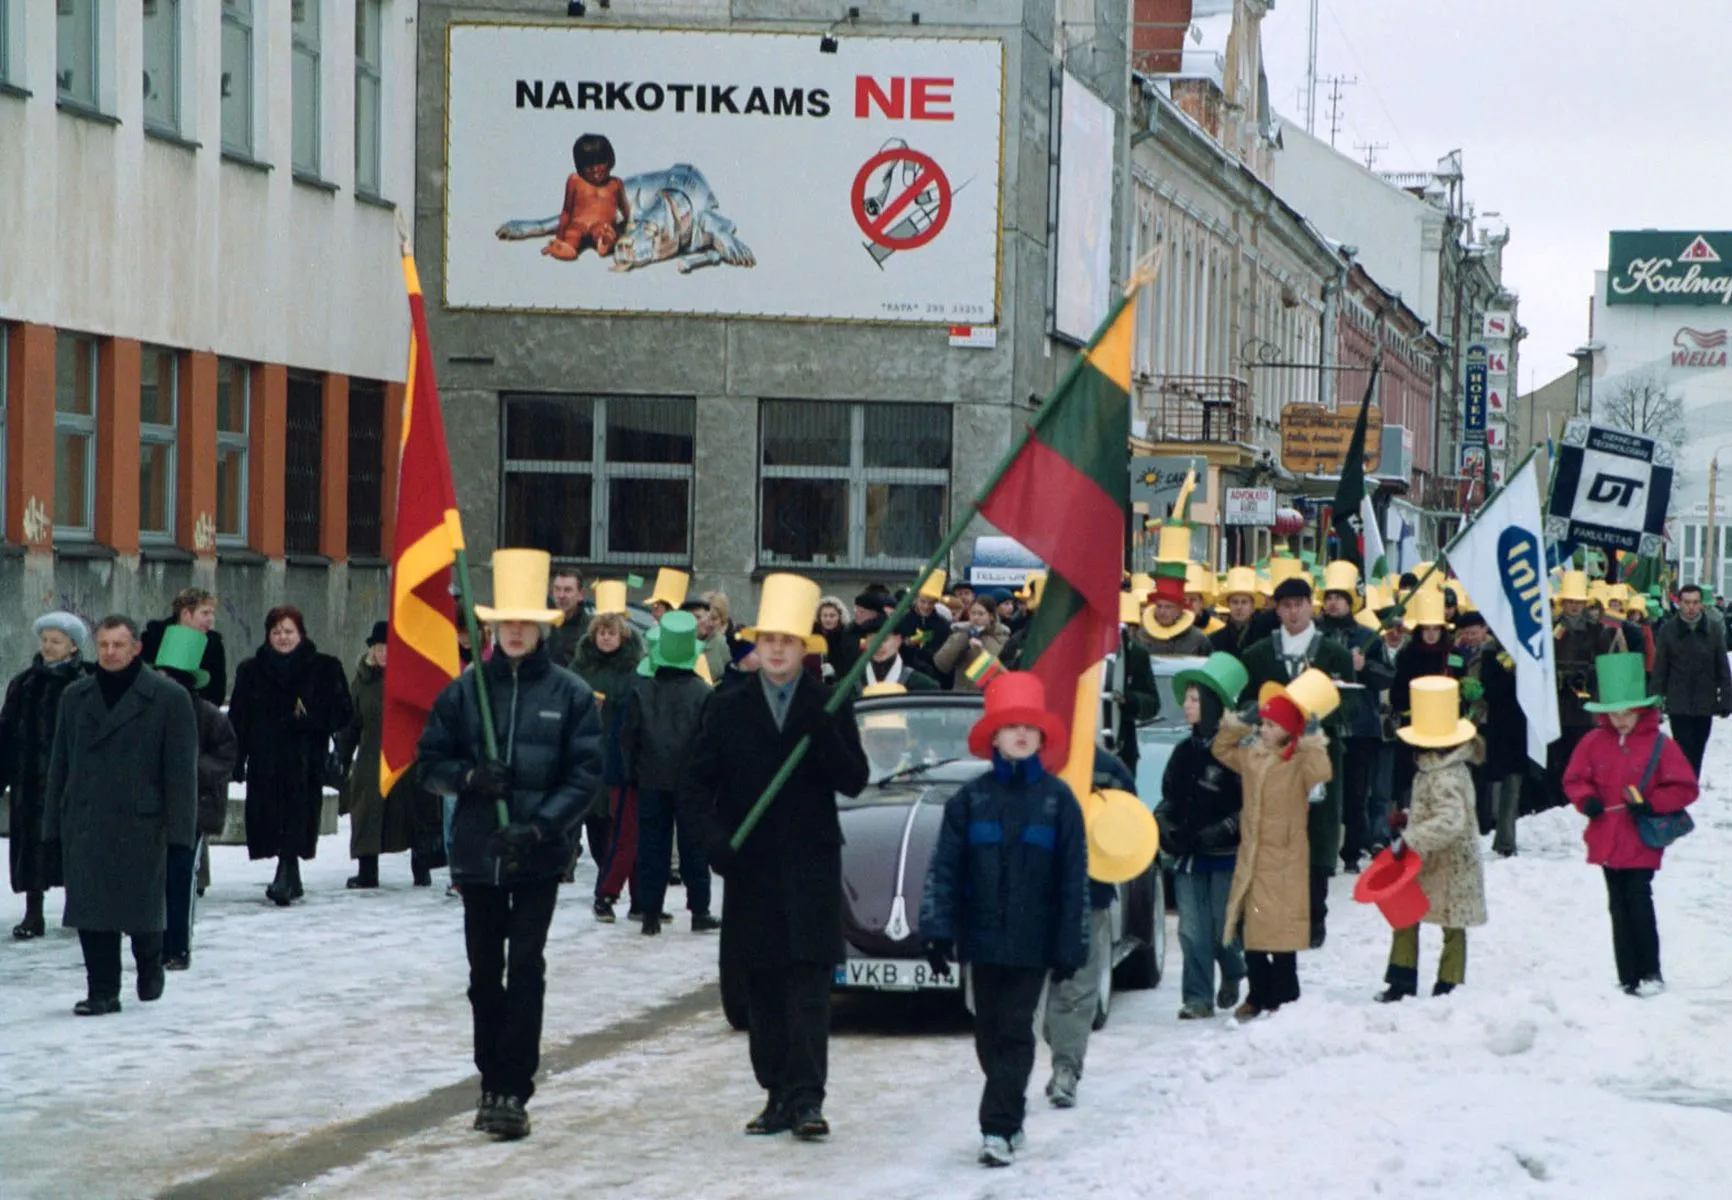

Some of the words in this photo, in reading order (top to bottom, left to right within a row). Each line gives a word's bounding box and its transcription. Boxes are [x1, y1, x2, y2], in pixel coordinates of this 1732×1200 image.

[515, 79, 831, 118] NARKOTIKAMS
[854, 75, 955, 121] NE
[1671, 350, 1727, 367] WELLA
[1469, 373, 1483, 426] HOTEL
[1587, 472, 1645, 508] DT
[850, 963, 898, 984] VKB
